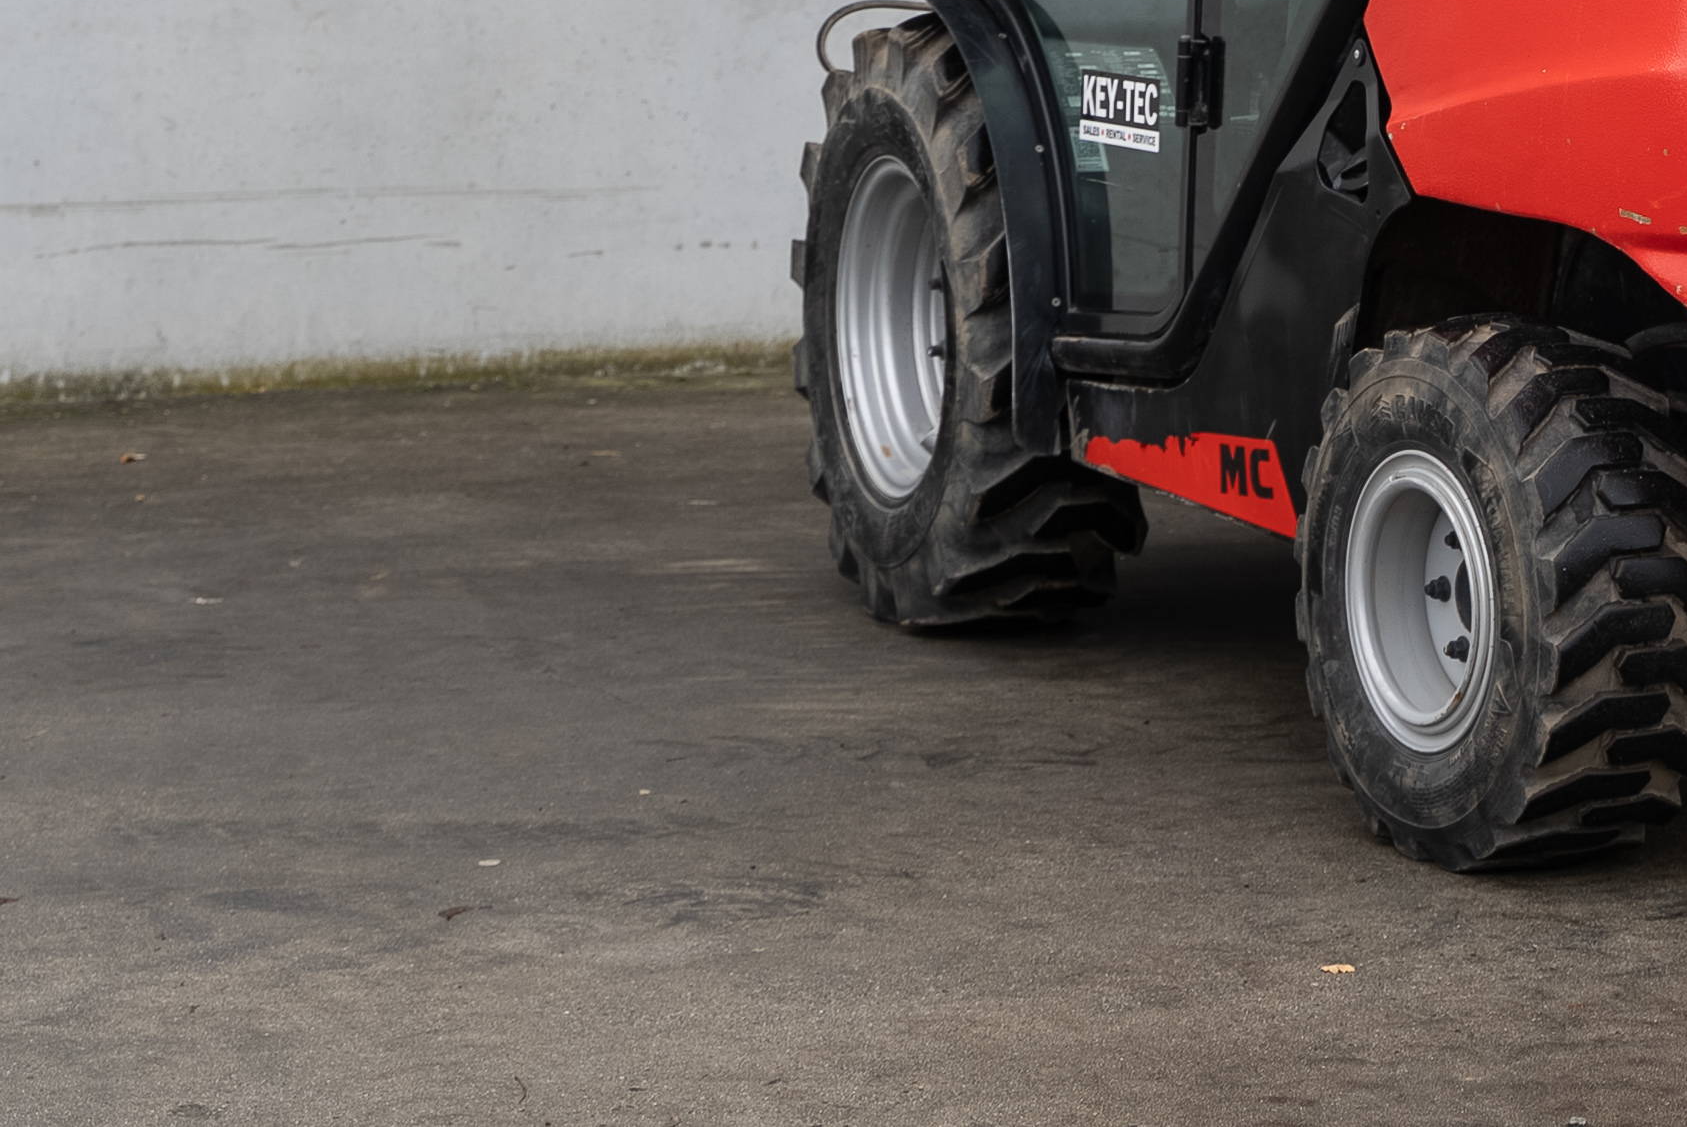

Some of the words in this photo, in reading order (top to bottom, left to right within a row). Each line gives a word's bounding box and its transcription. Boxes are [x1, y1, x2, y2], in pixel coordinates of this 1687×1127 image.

[1082, 74, 1158, 126] KEY-TEC
[1083, 124, 1100, 136] SALES
[1106, 128, 1127, 141] RENTAL
[1132, 133, 1156, 147] SERVICE
[1220, 443, 1274, 500] MC
